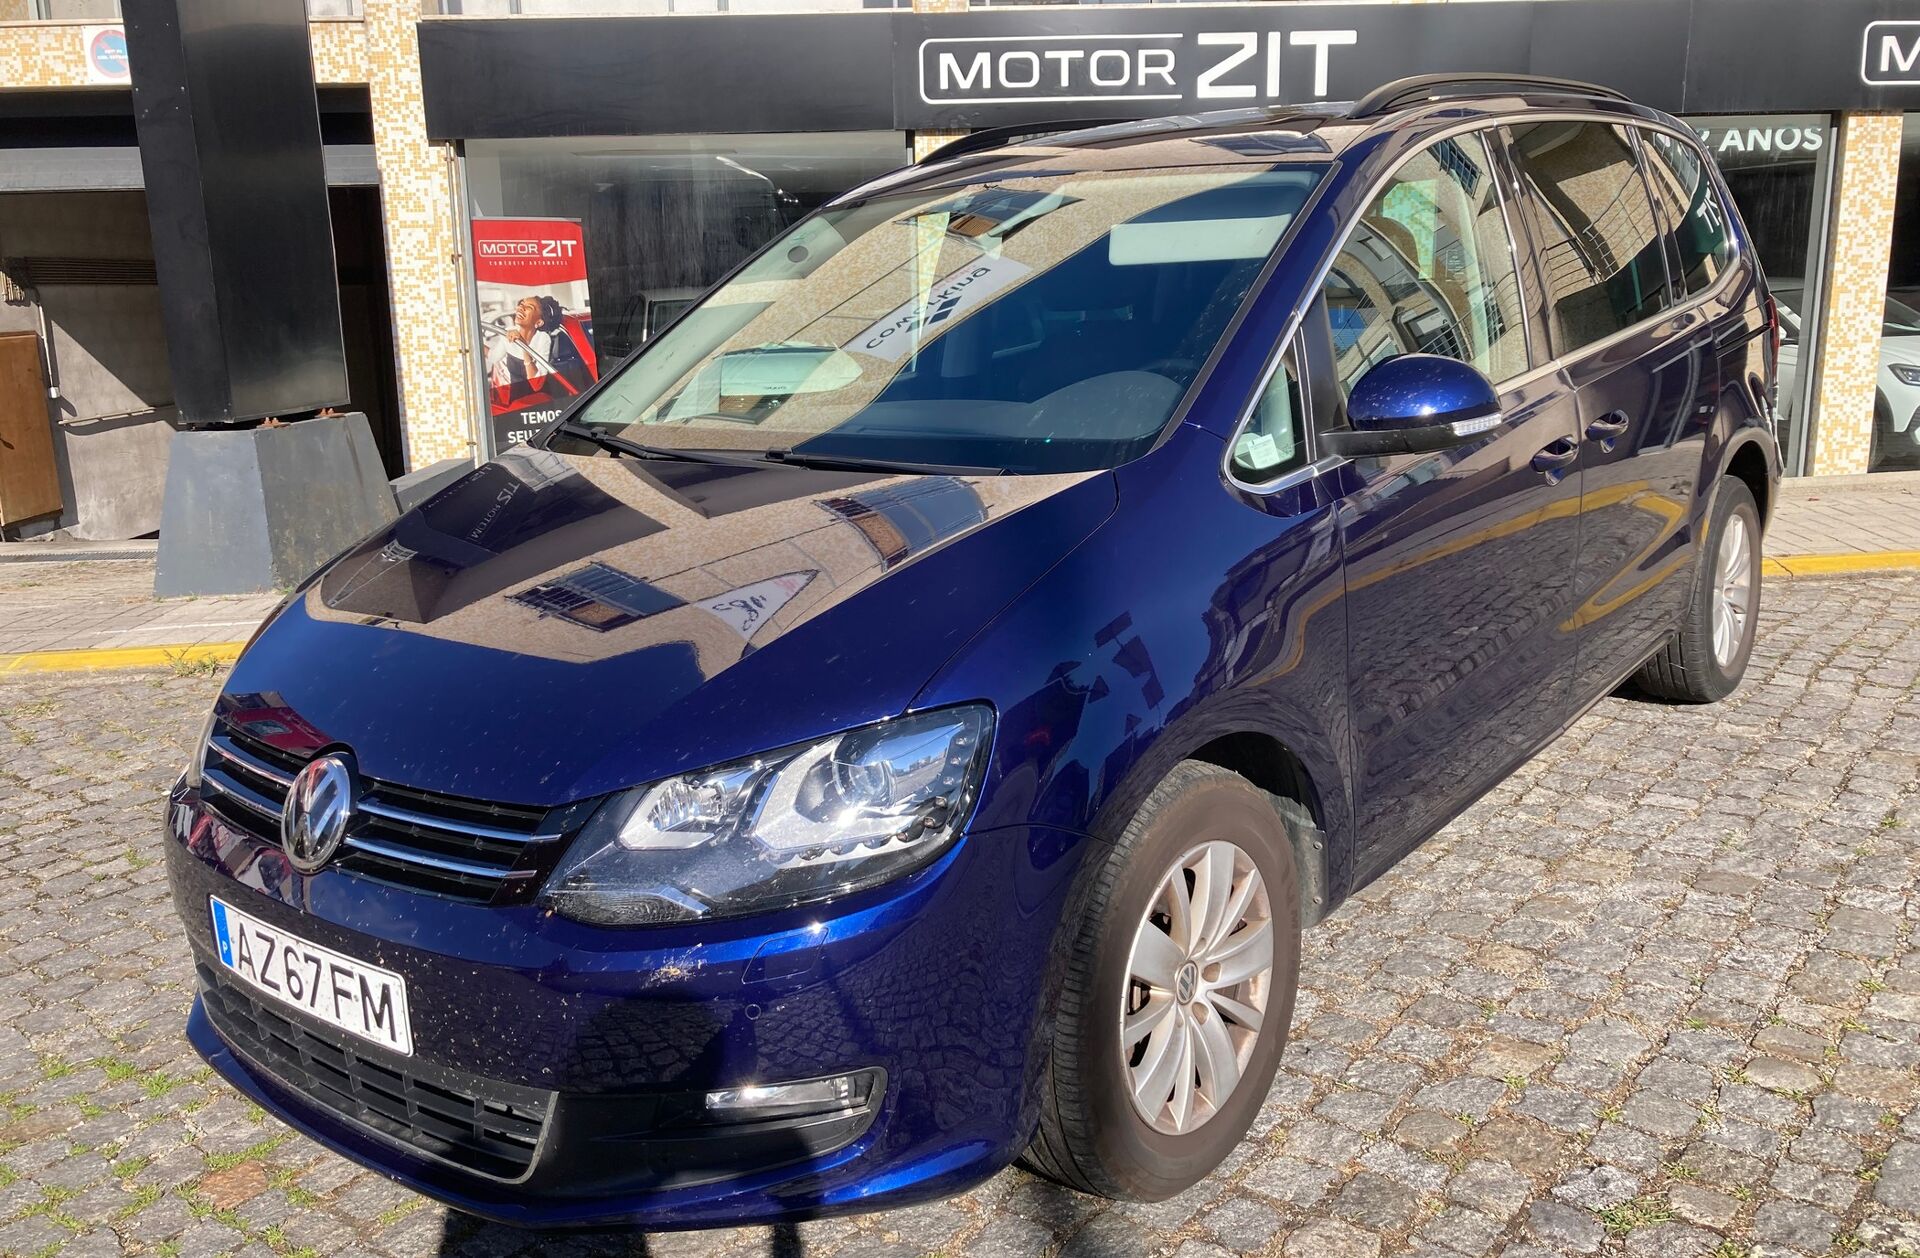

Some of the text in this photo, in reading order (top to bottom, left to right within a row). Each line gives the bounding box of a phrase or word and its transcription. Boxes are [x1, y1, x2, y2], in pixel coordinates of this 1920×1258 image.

[939, 30, 1358, 98] MOTOR ZIT
[1718, 127, 1823, 151] ANOS
[482, 240, 577, 257] MOTOR ZIT
[239, 922, 397, 1043] AZ67FM
